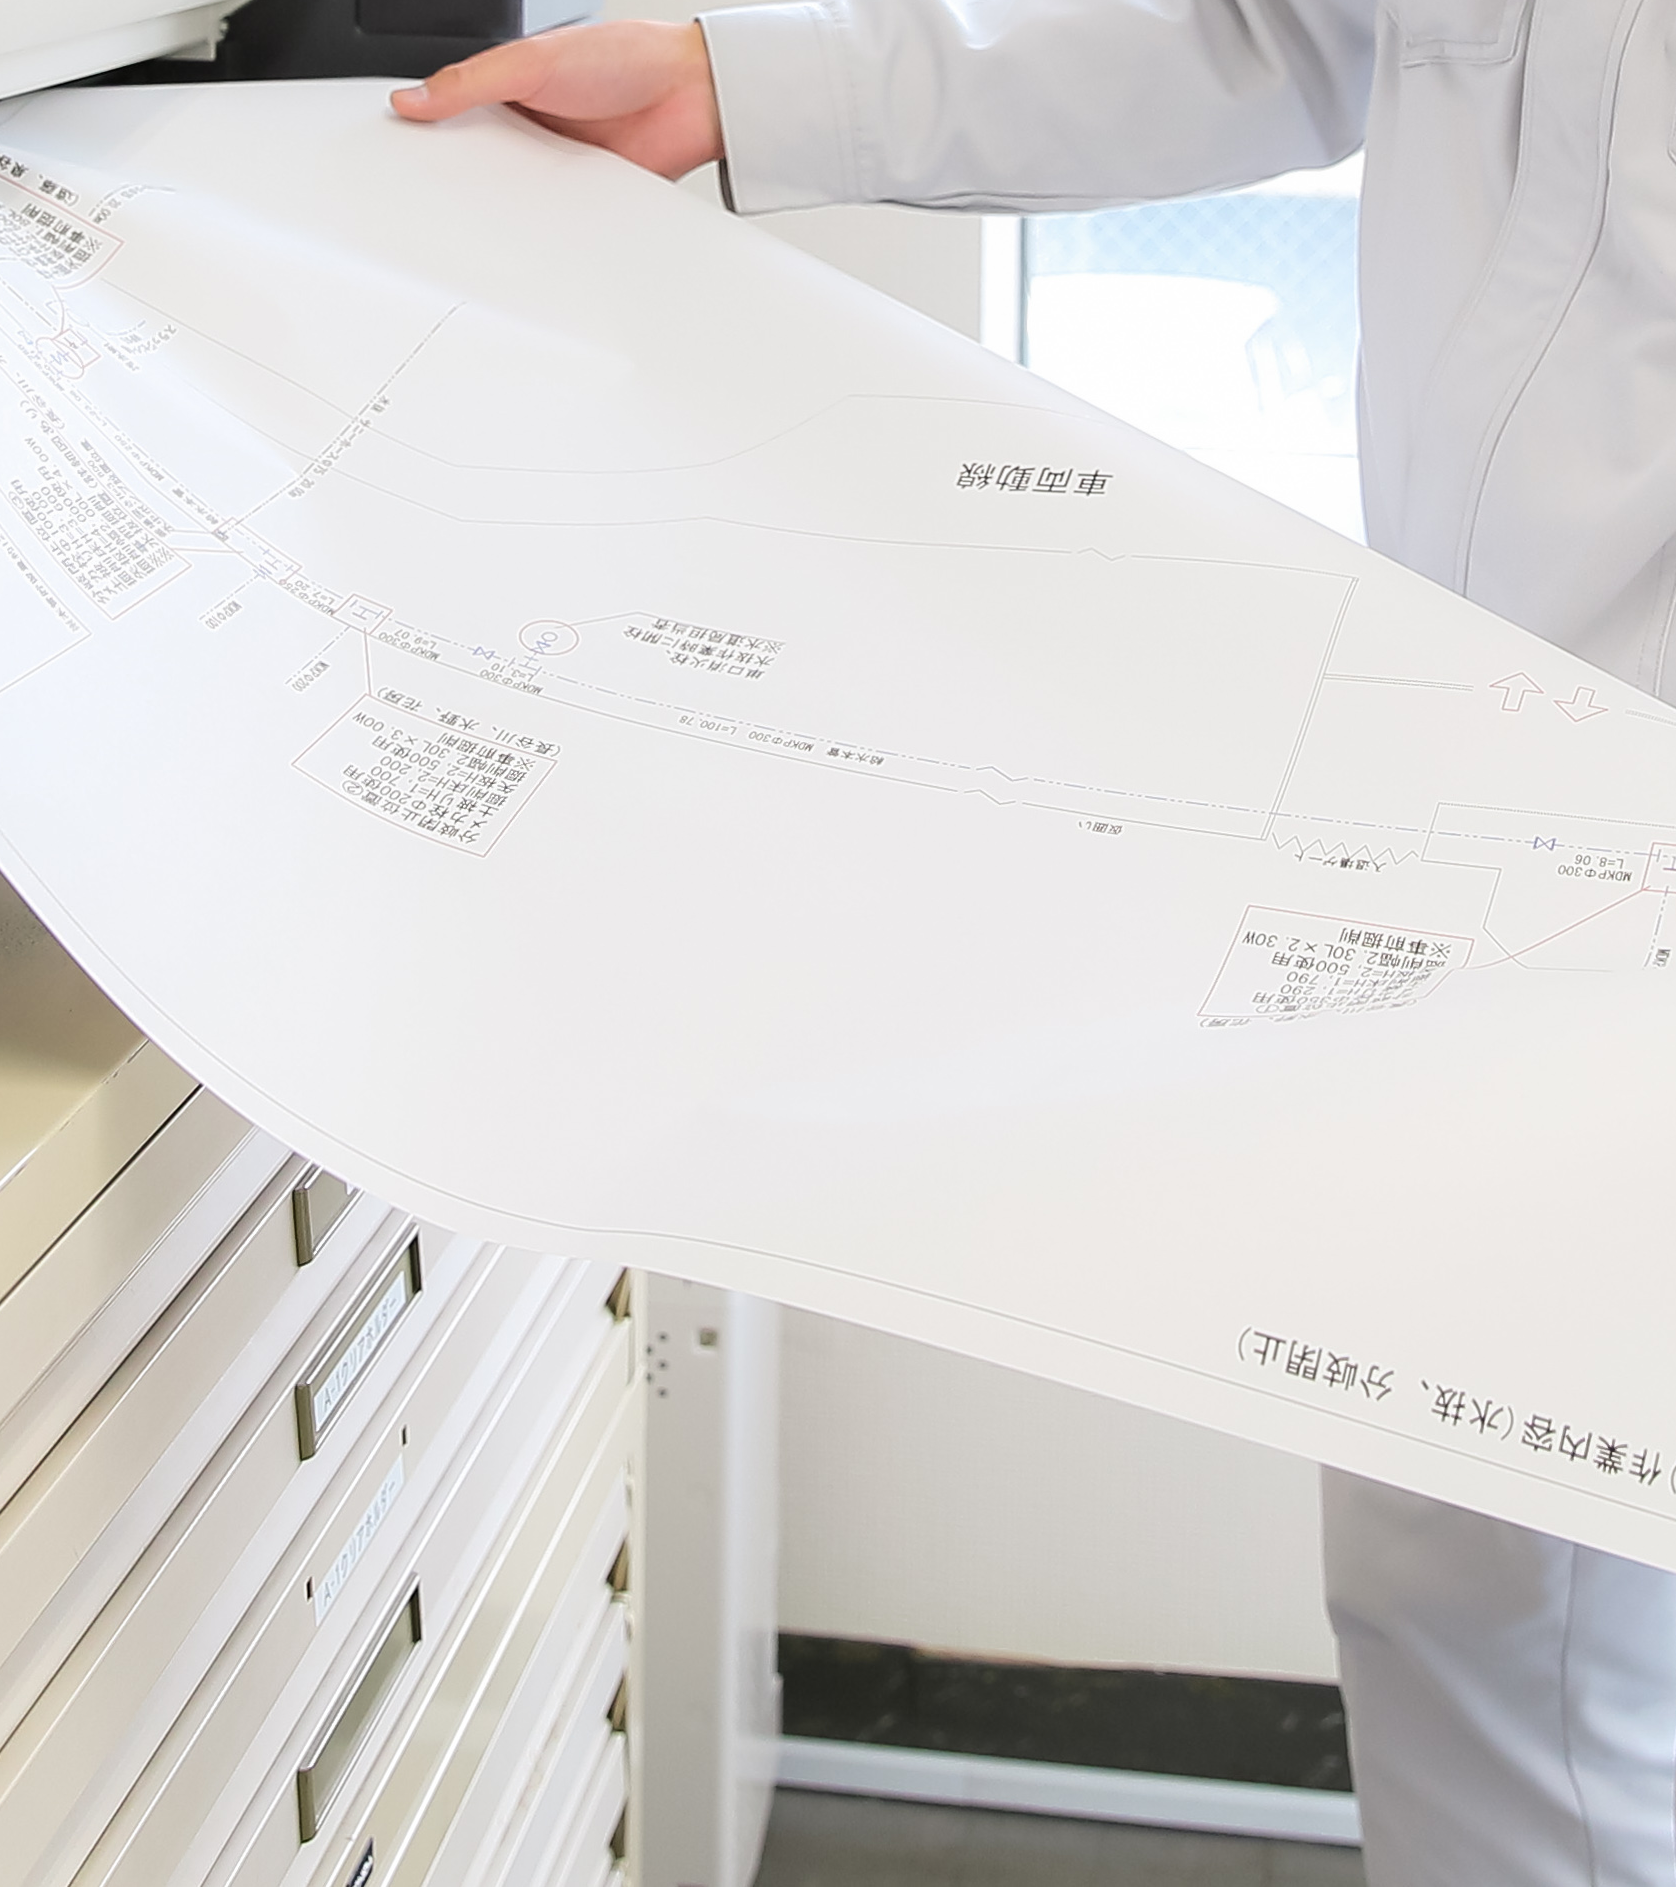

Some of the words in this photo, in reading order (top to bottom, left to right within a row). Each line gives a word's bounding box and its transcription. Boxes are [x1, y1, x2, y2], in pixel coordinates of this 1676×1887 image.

[956, 460, 1113, 497] 車両動線
[1338, 926, 1452, 959] ※事前掘削
